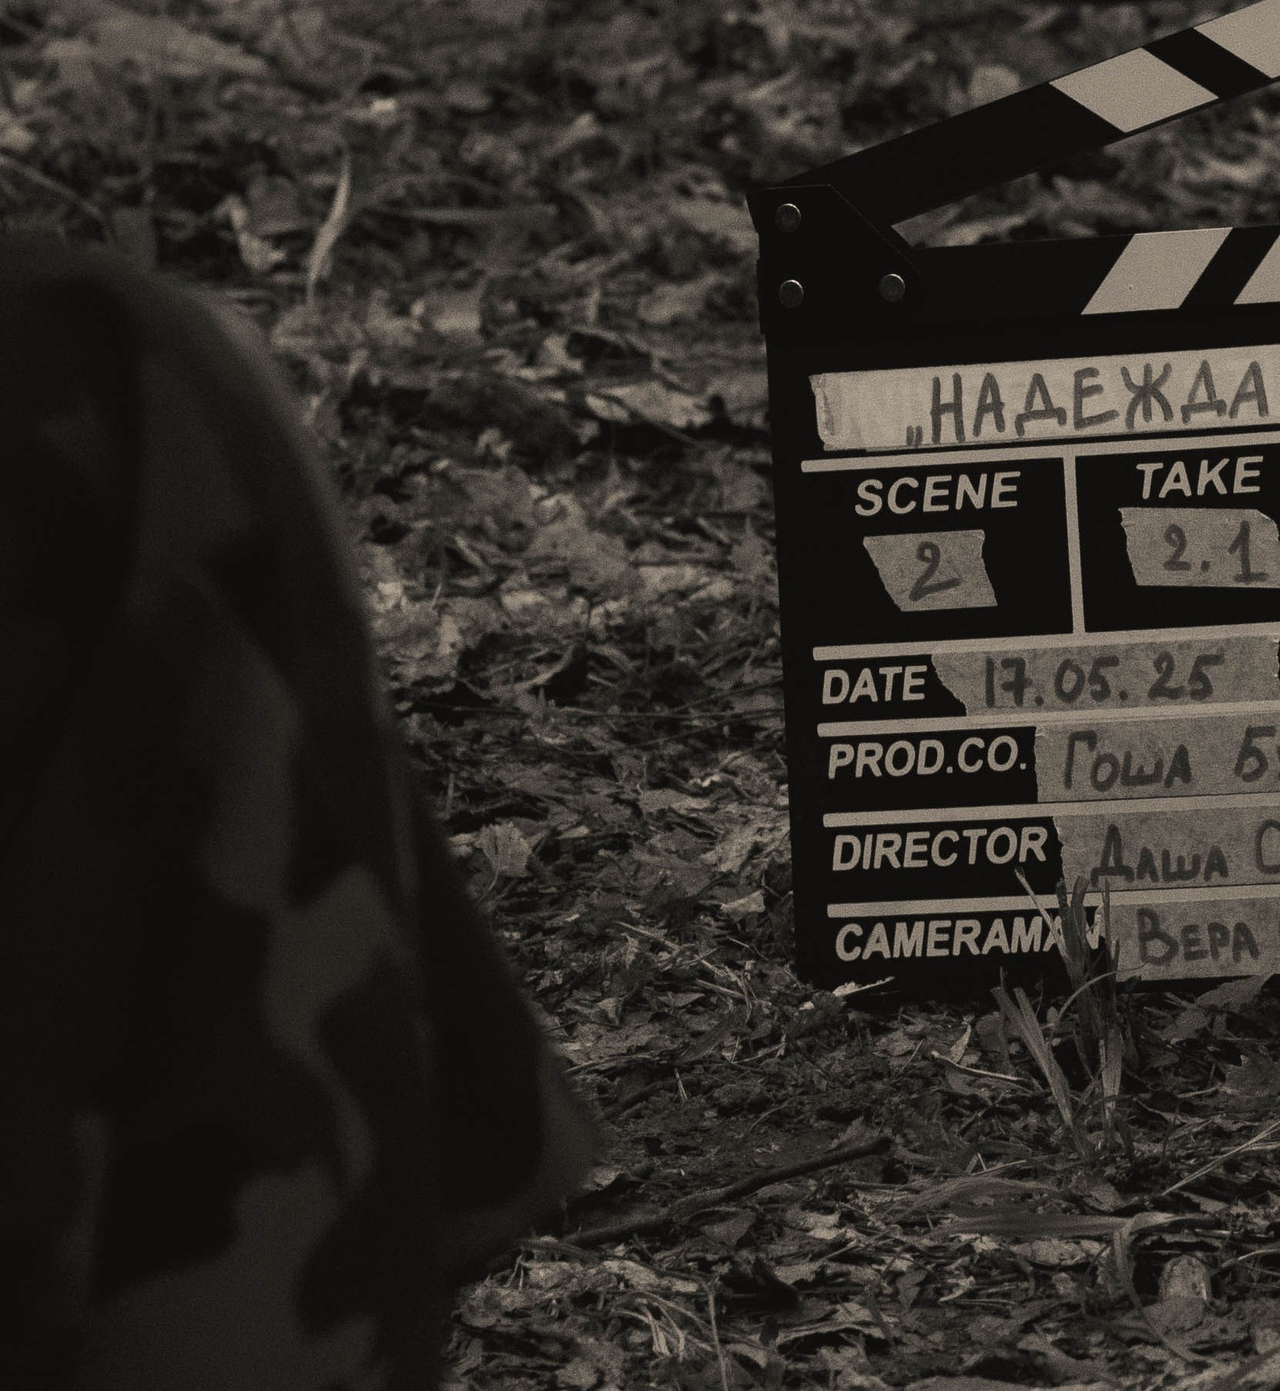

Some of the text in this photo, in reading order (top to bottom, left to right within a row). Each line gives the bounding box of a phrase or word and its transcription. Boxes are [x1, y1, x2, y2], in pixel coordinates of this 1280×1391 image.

[854, 470, 1021, 515] SCENE
[1136, 456, 1265, 499] TAKE
[908, 540, 959, 602] 2
[1162, 519, 1269, 584] 2.1
[821, 664, 929, 707] DATE
[827, 734, 1027, 780] PROD.CO.
[831, 825, 1049, 872] DIRECTOR
